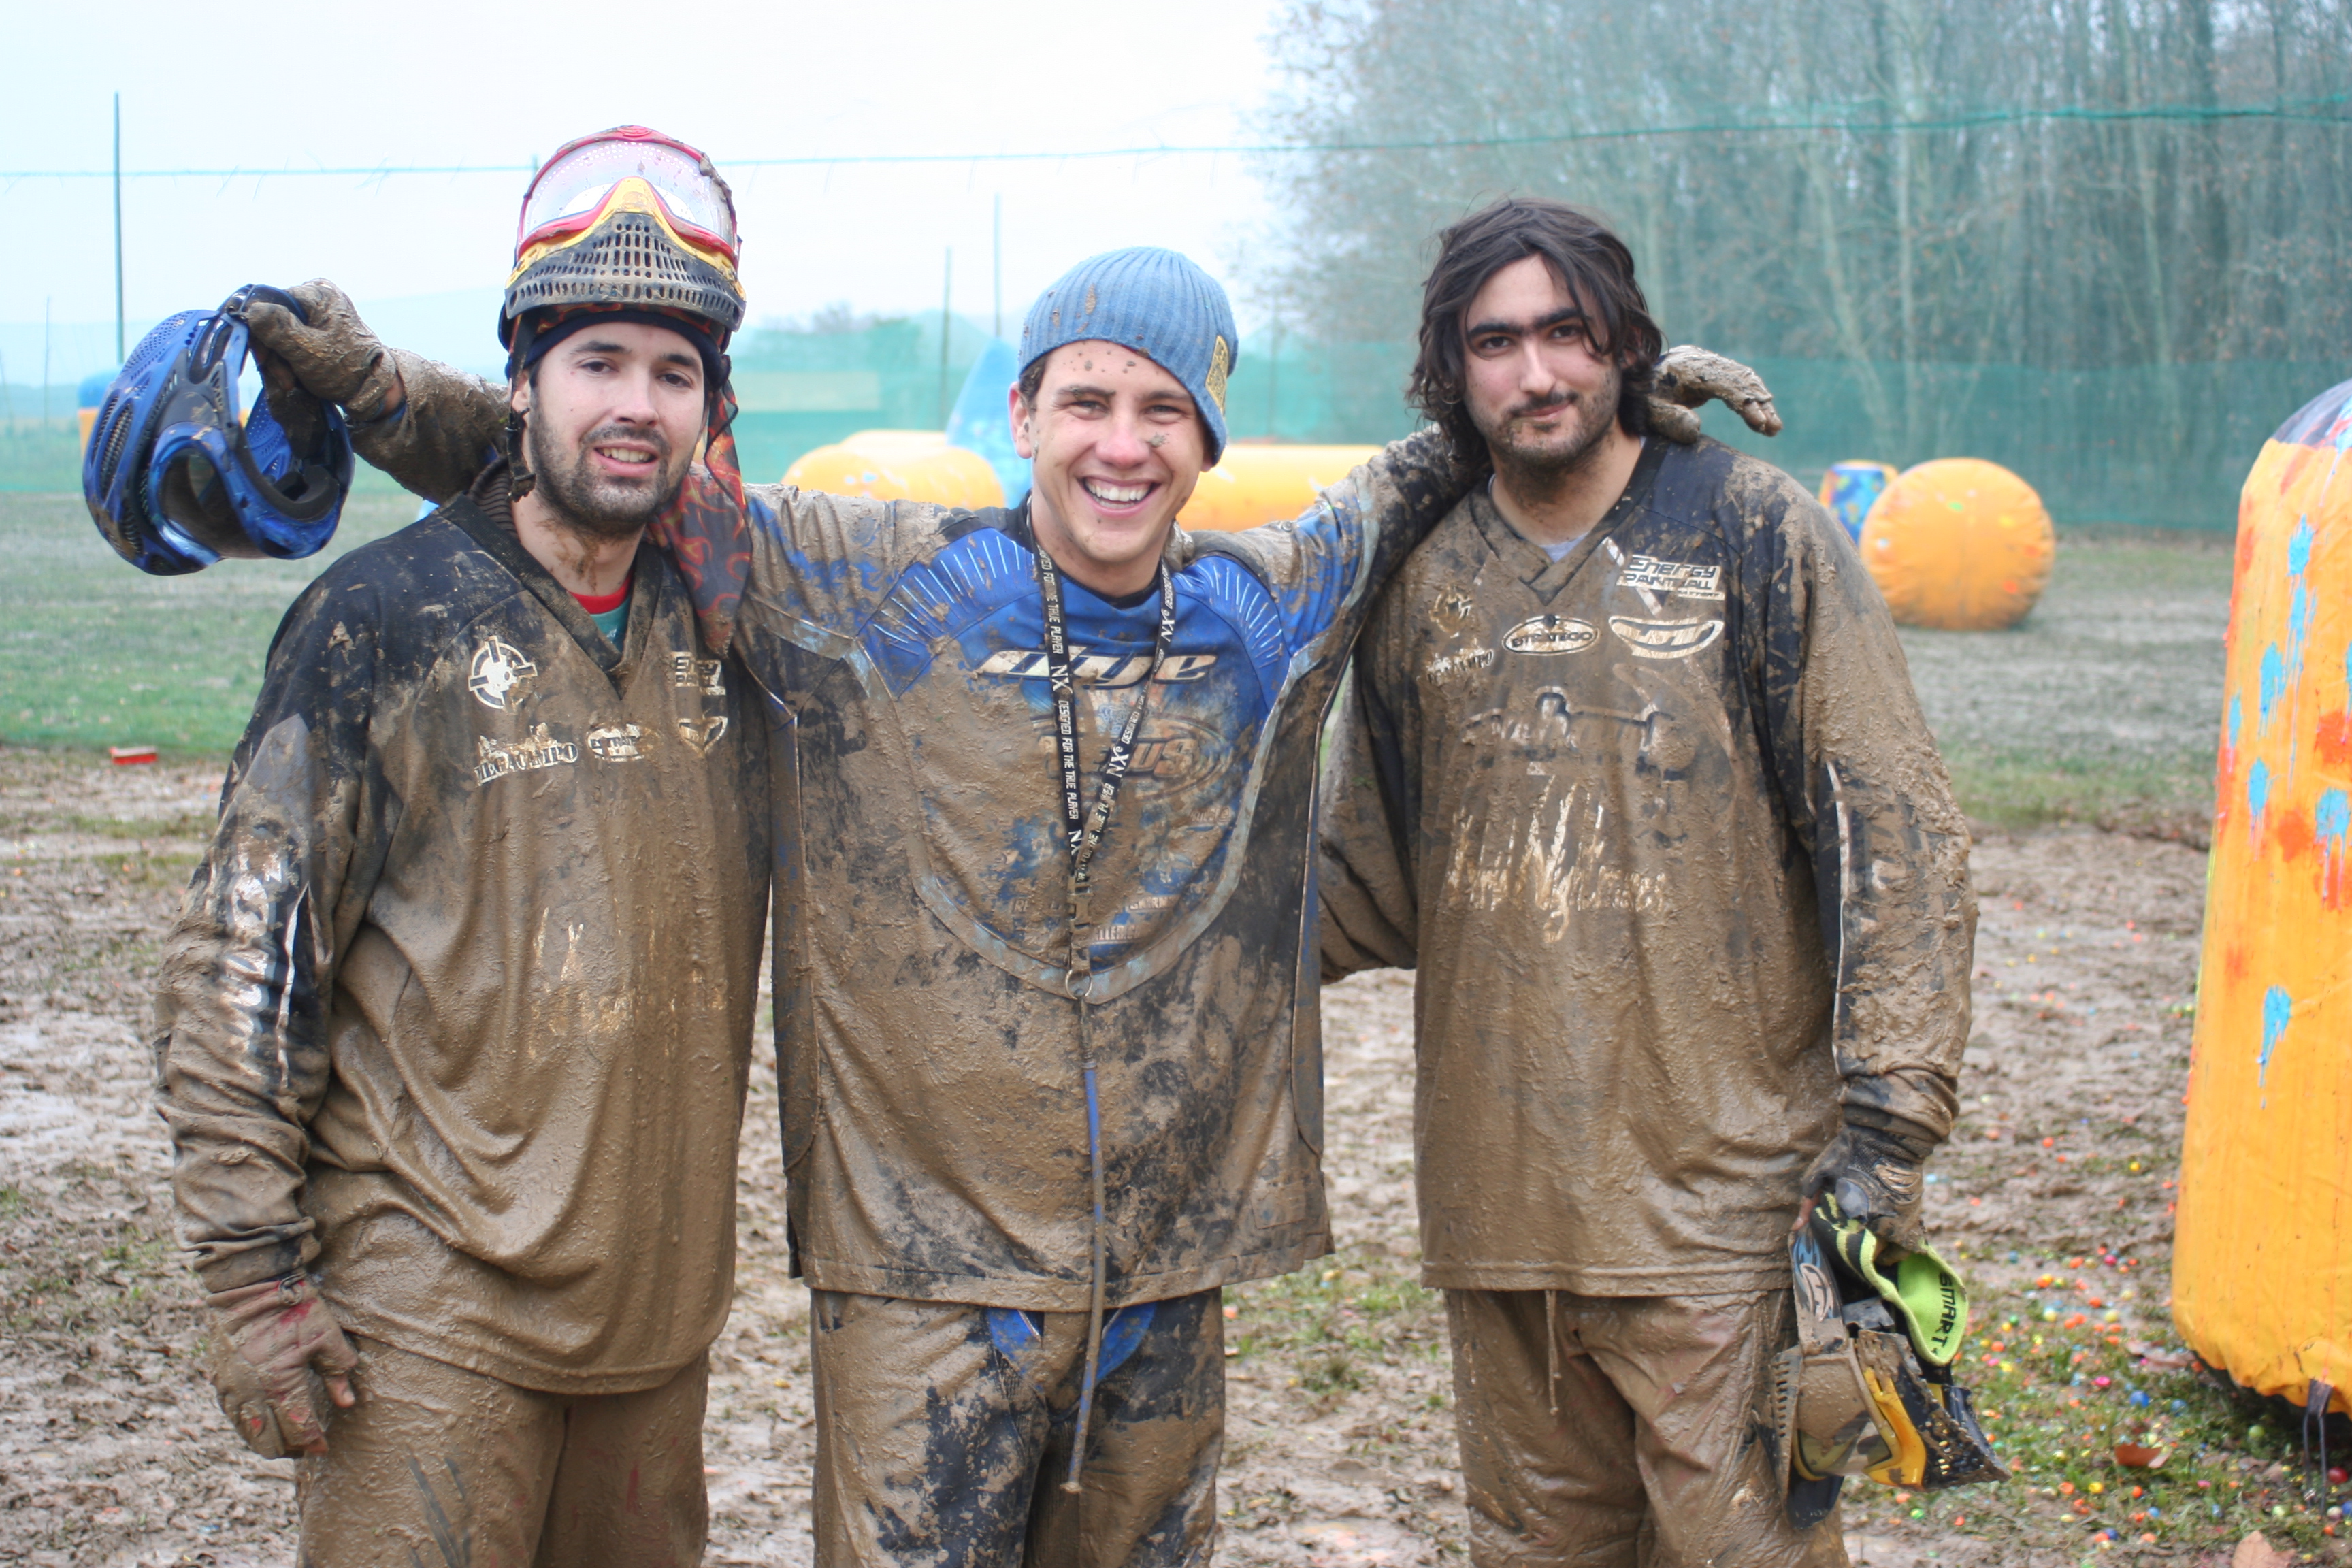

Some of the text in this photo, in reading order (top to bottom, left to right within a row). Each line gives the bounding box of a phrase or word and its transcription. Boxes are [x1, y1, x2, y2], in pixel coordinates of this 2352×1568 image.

[1624, 573, 1712, 590] PAINTALL
[1048, 604, 1060, 623] TRUE
[1050, 625, 1064, 655] PLAYER
[1058, 700, 1072, 735] DESIGNED
[1062, 737, 1074, 753] FOR
[1064, 754, 1075, 769] THE
[1065, 770, 1077, 789] TRUE
[1066, 792, 1079, 820] PLAYER
[1931, 1272, 1956, 1348] SMART
